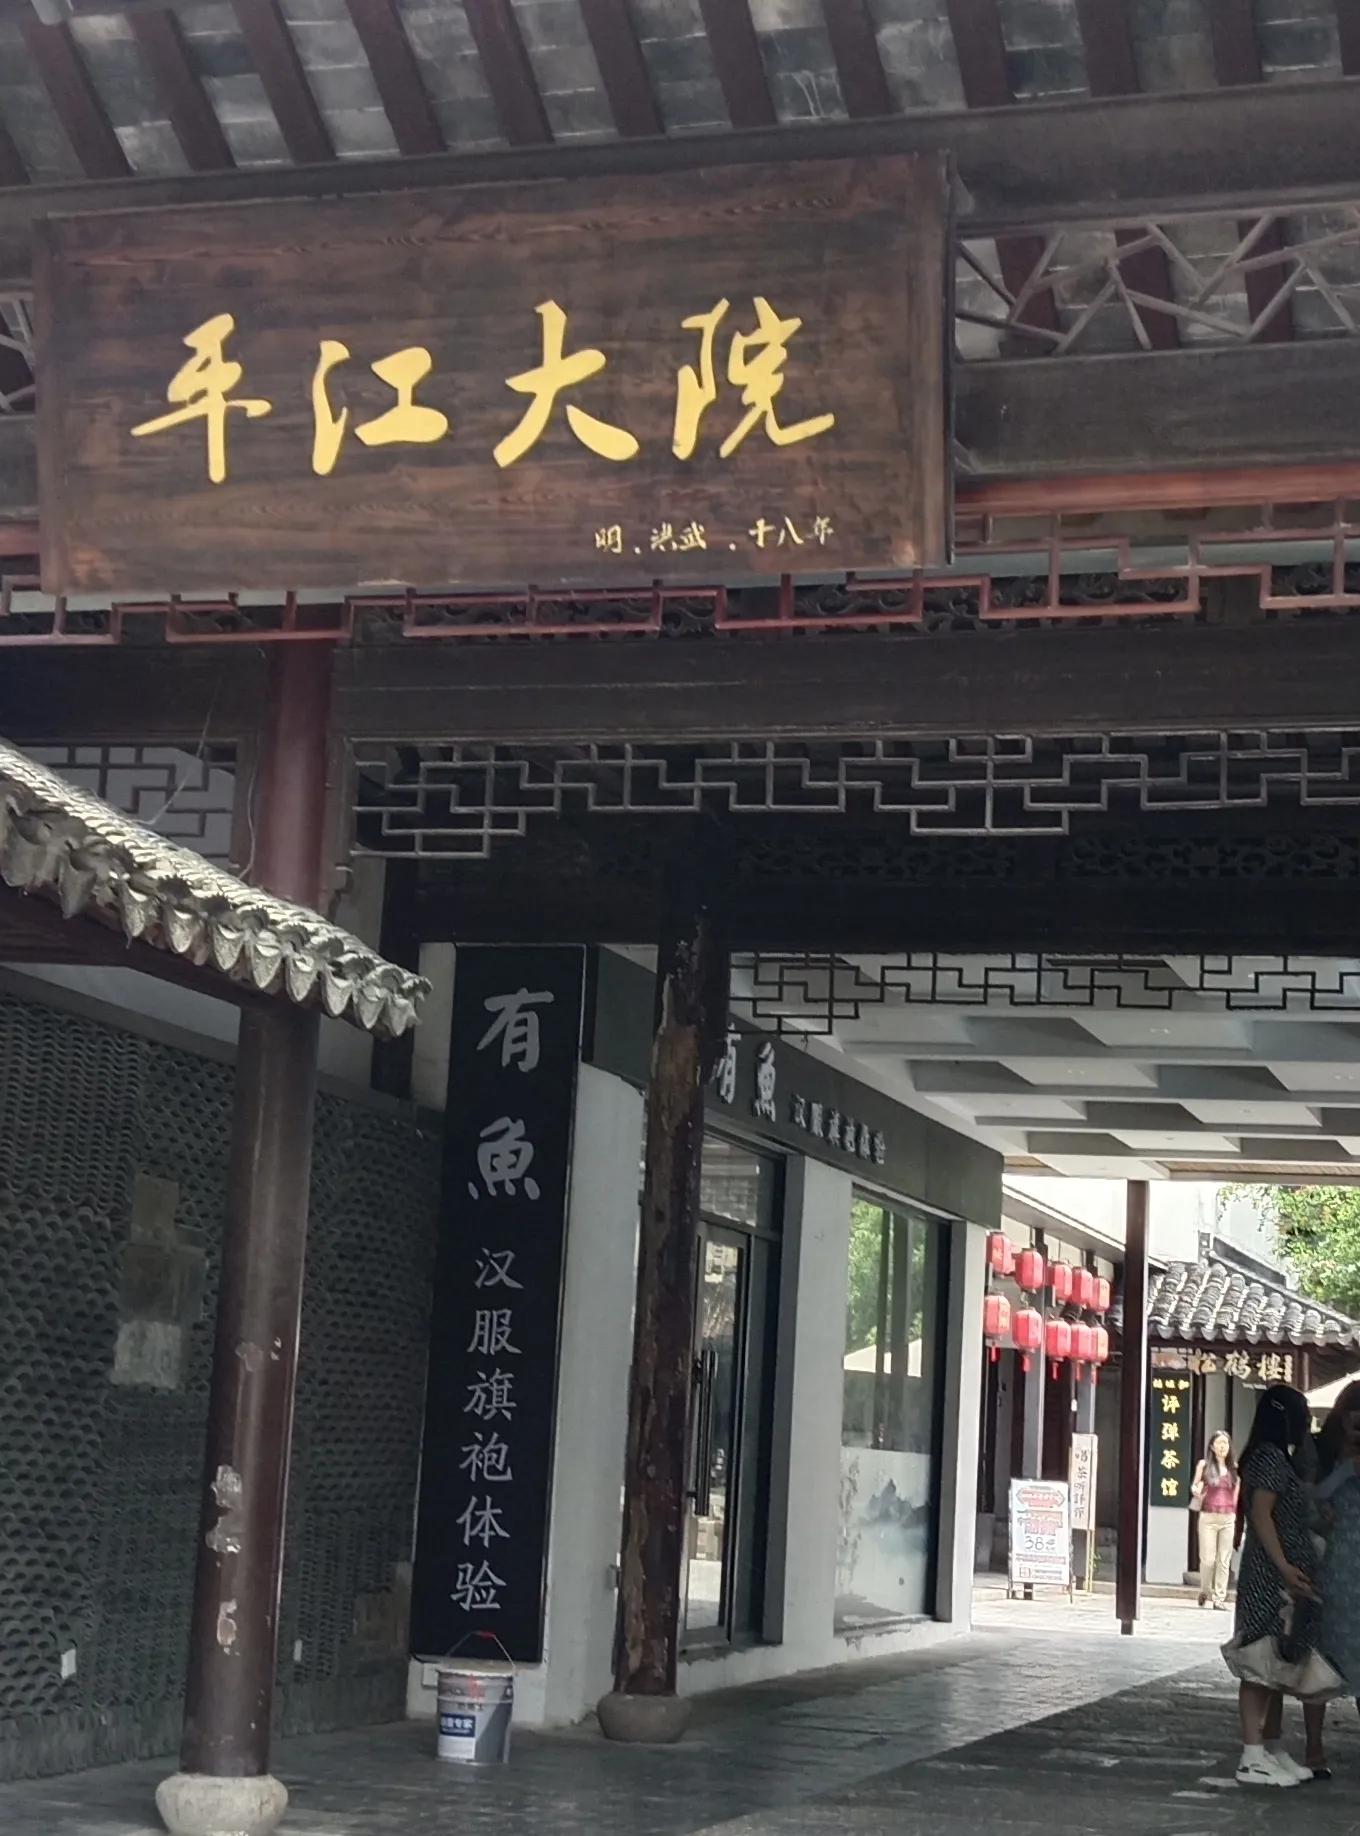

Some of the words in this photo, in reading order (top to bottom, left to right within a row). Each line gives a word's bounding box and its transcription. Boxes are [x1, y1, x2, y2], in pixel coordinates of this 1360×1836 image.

[131, 297, 835, 484] 平江大院
[450, 1246, 524, 1613] 汉服旗袍体验
[1161, 1394, 1180, 1497] 评弹茶馆
